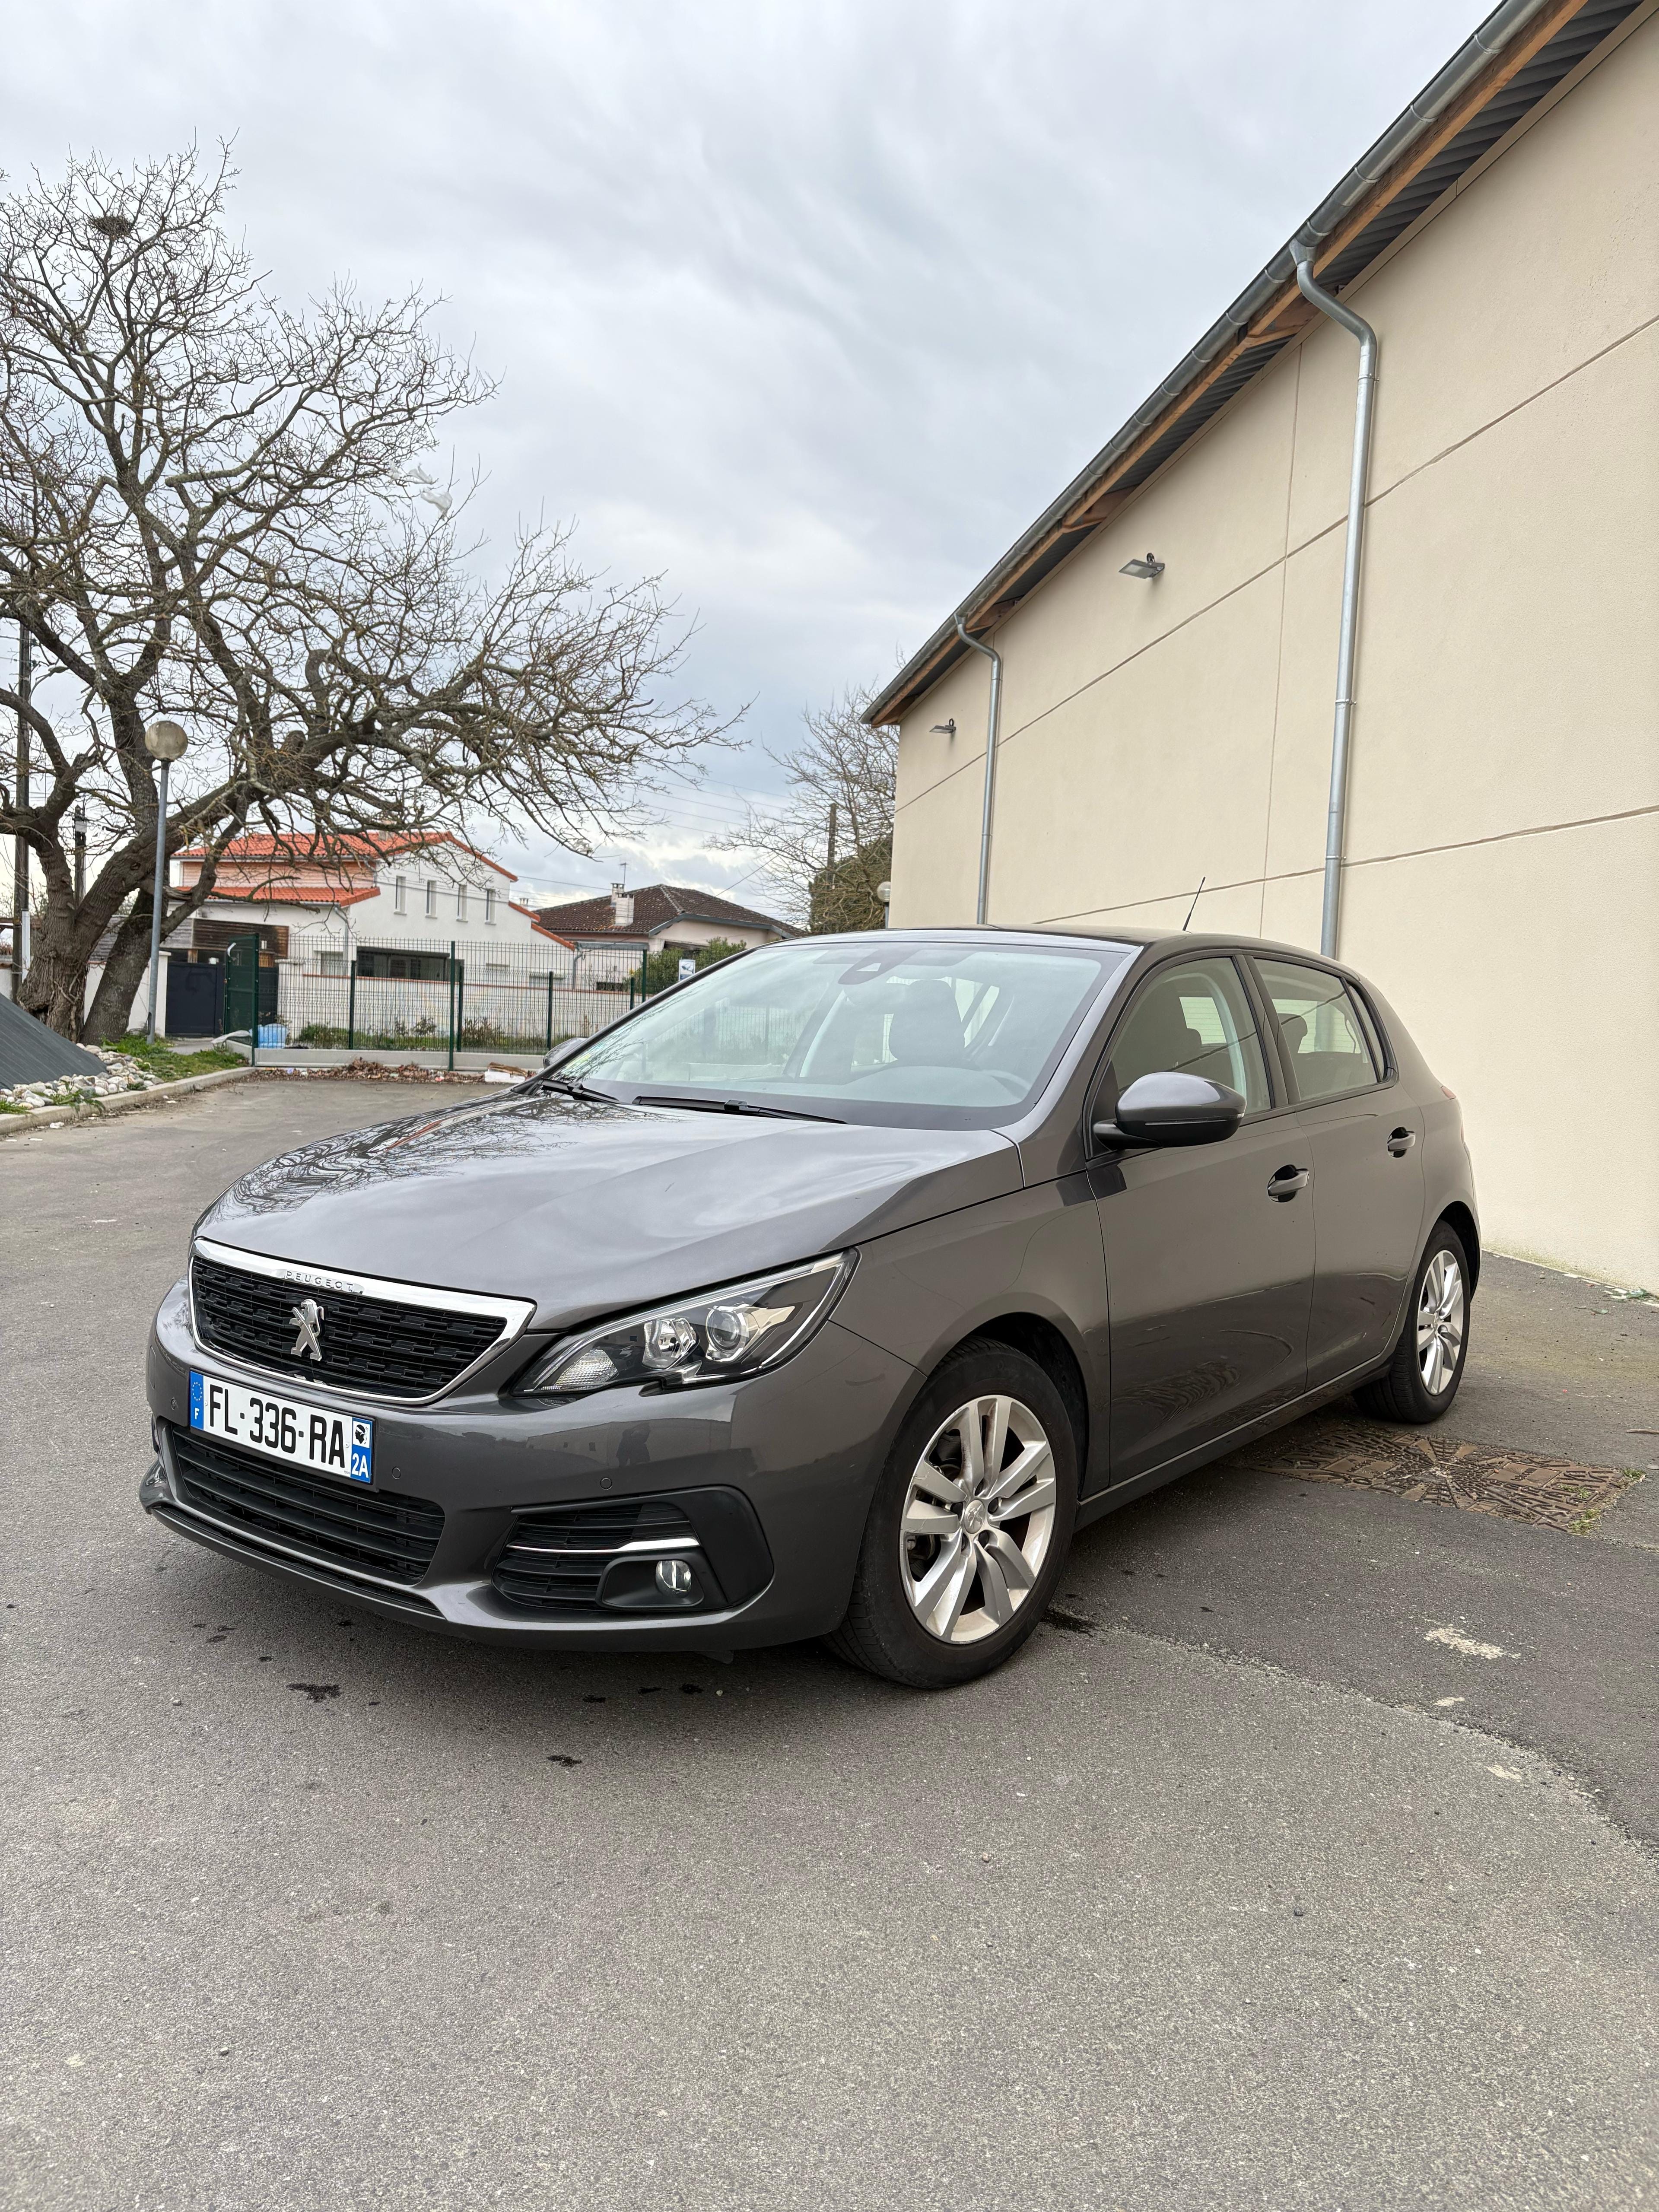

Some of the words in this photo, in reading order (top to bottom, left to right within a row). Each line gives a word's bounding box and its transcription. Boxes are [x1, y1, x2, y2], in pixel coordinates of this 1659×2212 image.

[286, 1271, 353, 1292] PEUGEOT
[194, 1408, 200, 1420] F
[352, 1452, 369, 1478] 2A
